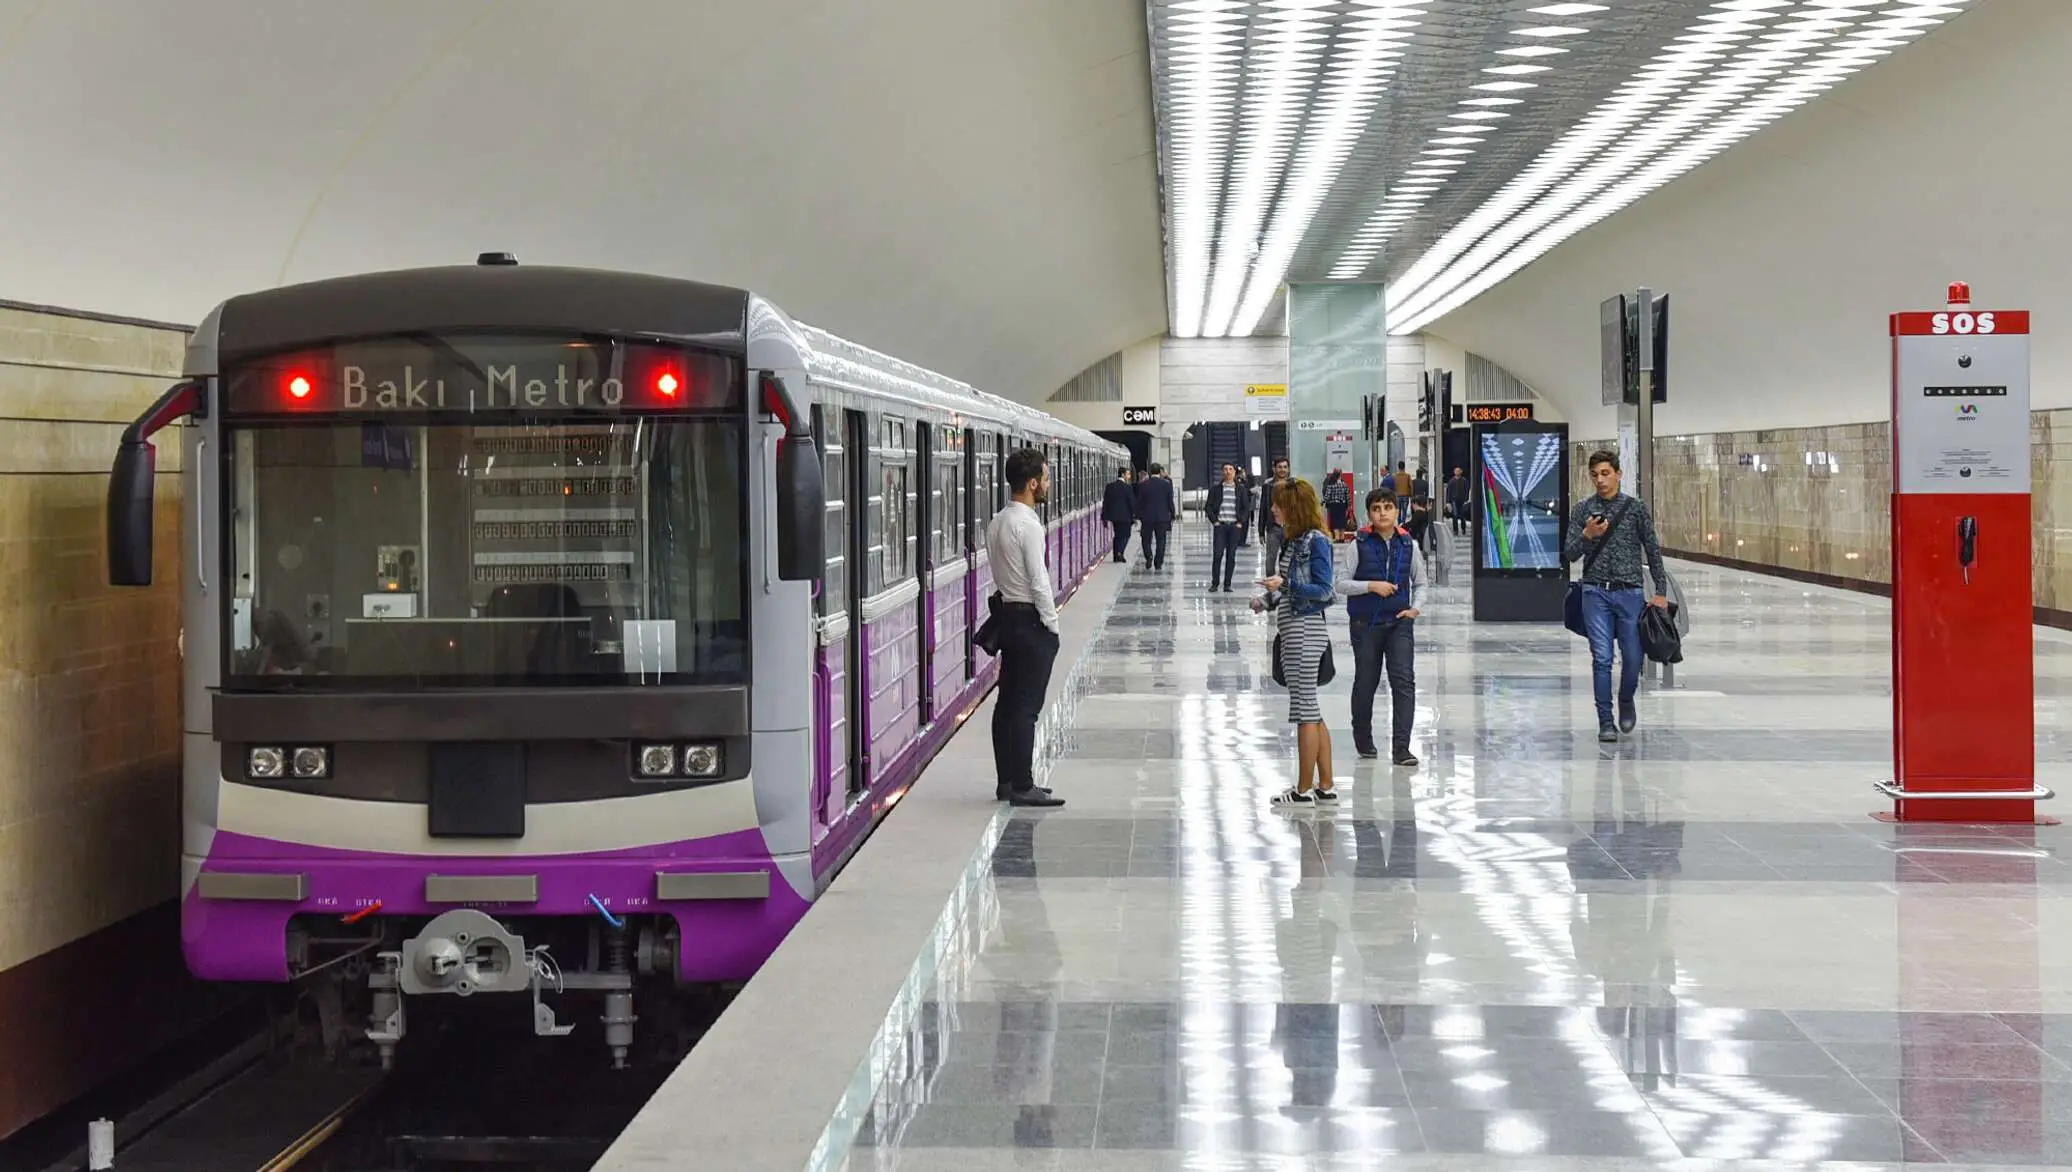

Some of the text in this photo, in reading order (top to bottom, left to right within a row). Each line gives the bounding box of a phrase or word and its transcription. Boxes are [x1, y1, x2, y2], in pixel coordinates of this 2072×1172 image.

[1932, 312, 1995, 334] SOS
[343, 364, 624, 408] Bakı Metro
[1468, 408, 1529, 420] 14:38:43 04:00
